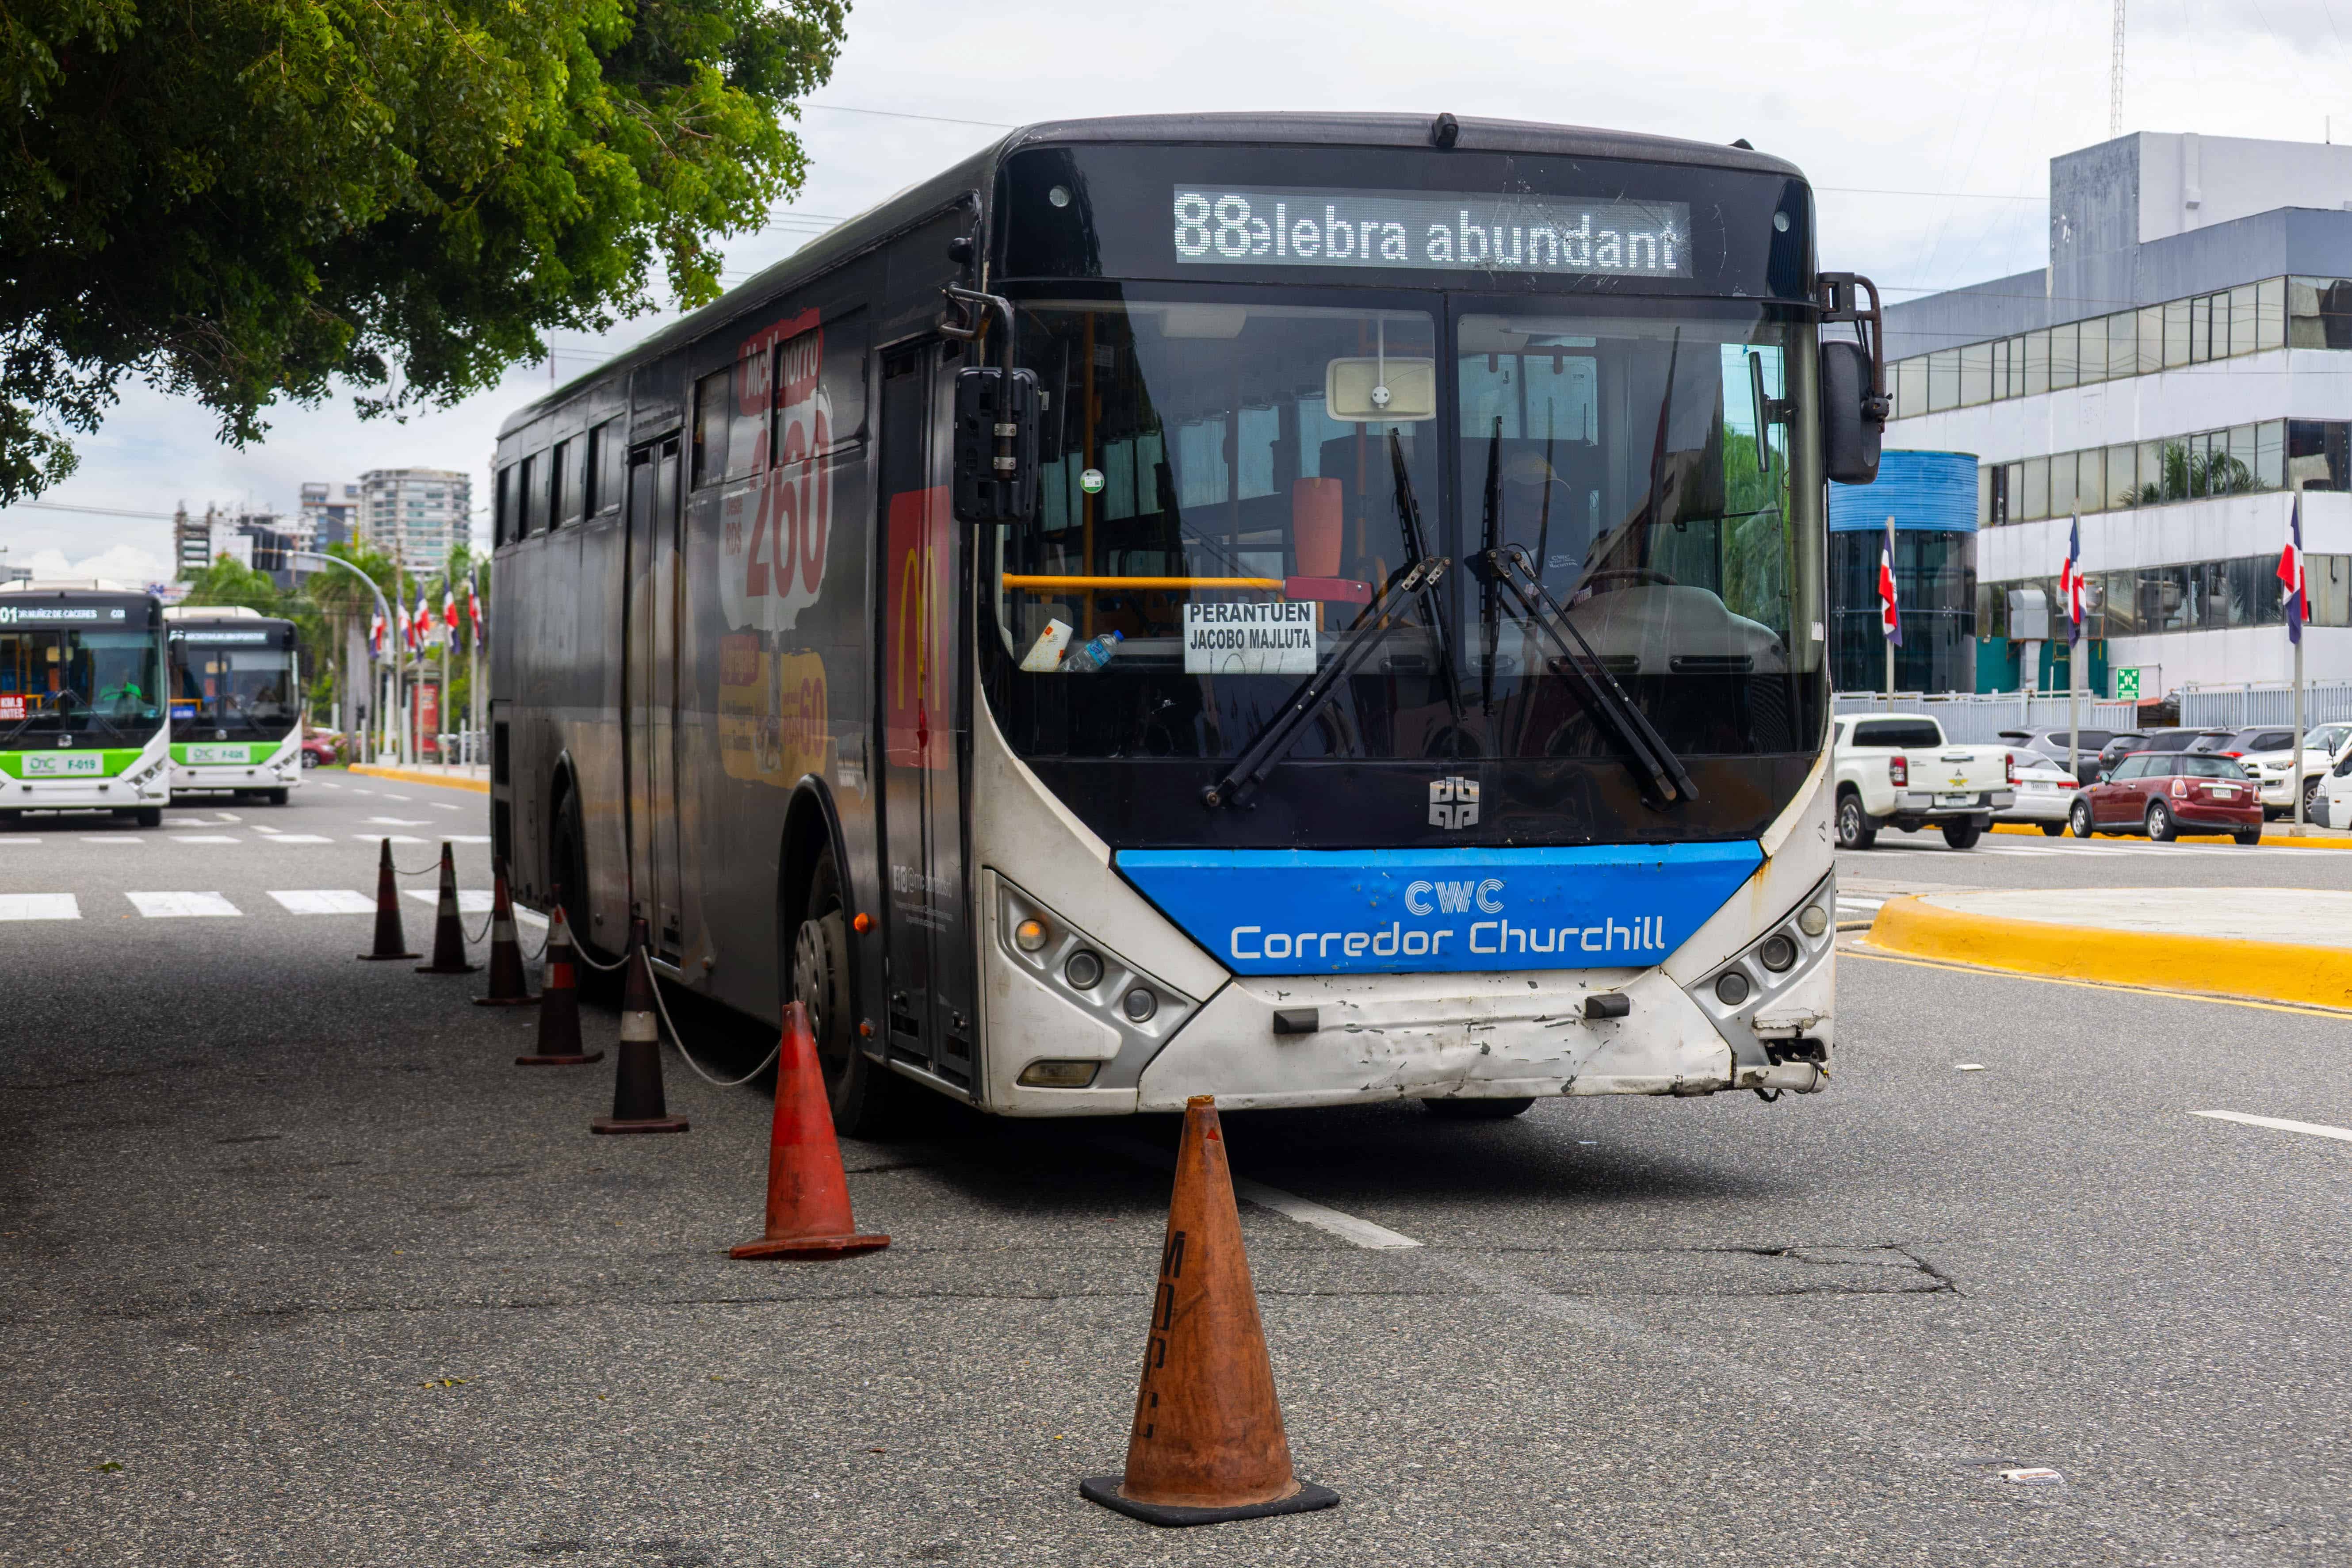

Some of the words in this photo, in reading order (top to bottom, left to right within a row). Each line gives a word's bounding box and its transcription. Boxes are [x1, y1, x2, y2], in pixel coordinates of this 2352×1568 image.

[1174, 193, 1251, 257] 88
[1426, 210, 1677, 269] abundant
[746, 409, 829, 598] 260
[1189, 603, 1311, 623] PERANTUEN
[1190, 629, 1245, 650] JACOBO
[1250, 628, 1311, 649] MAJLUTA
[799, 677, 825, 757] 60
[68, 755, 96, 769] F-019
[1404, 878, 1505, 916] CWC
[1231, 920, 1454, 960] Corredor
[1469, 915, 1666, 954] Churchill
